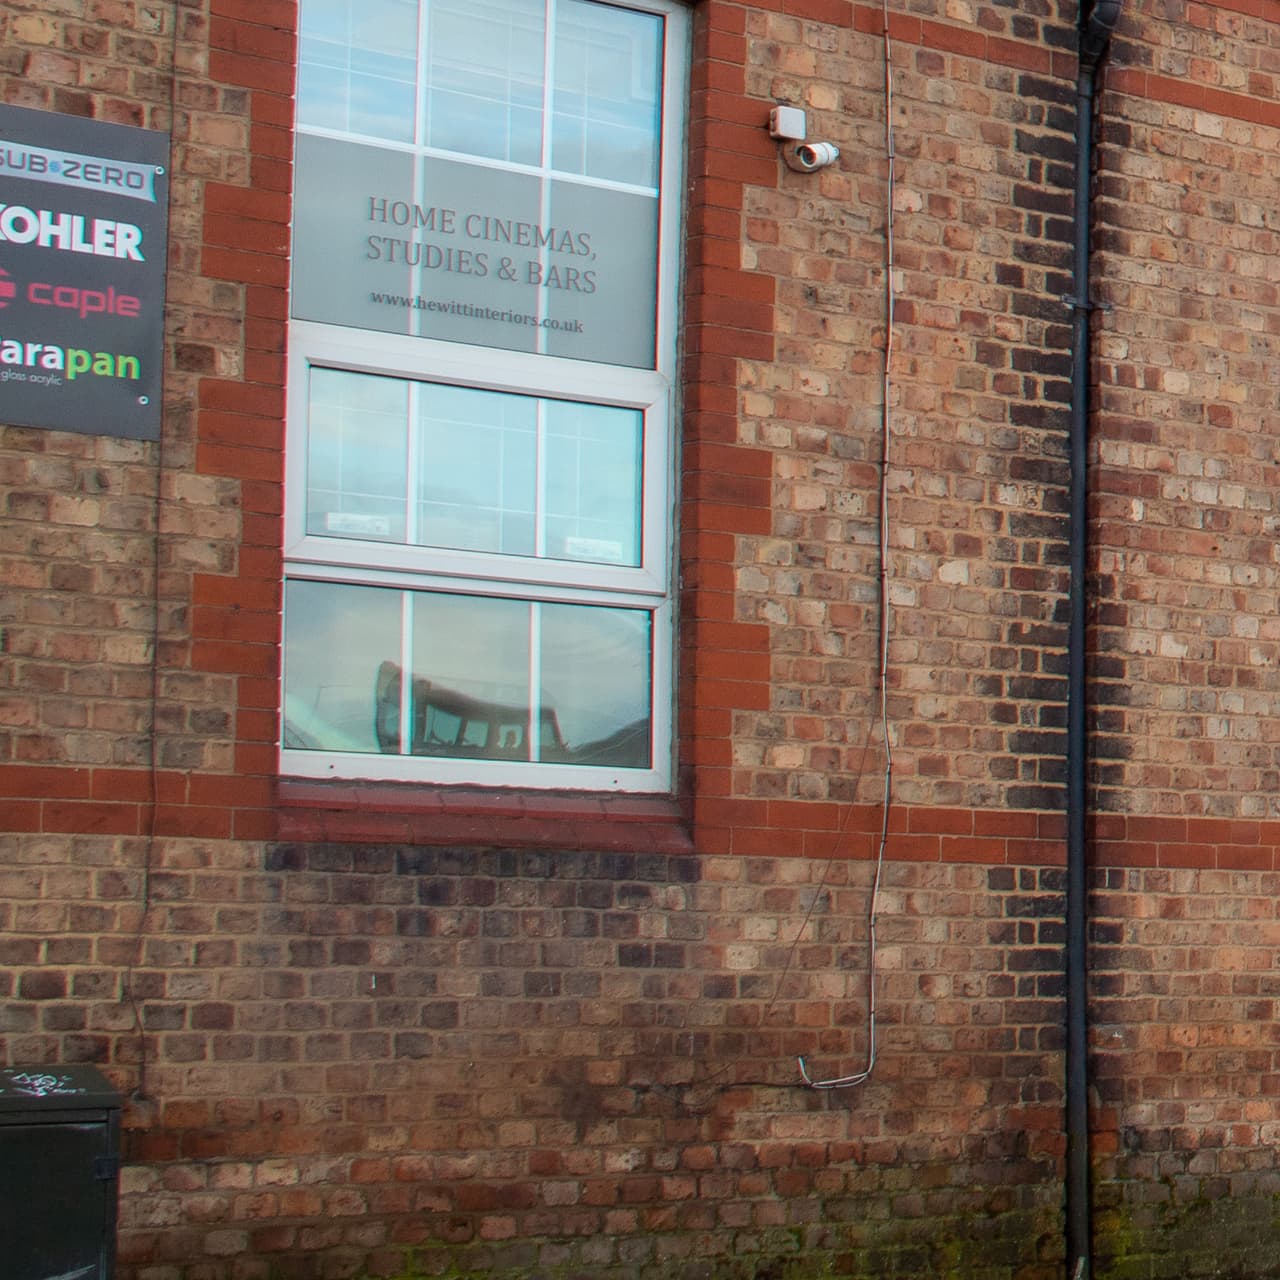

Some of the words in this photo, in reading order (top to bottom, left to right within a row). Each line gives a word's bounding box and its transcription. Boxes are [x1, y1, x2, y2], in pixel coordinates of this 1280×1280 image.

[0, 204, 145, 261] OHLER
[368, 196, 456, 234] HOME
[465, 214, 598, 261] CINEMAS,
[367, 235, 489, 277] STUDIES
[497, 256, 518, 282] &
[527, 261, 597, 294] BARS
[28, 281, 141, 319] caple
[370, 291, 584, 333] www.hewittinteriors.co.uk
[0, 337, 141, 380] arapan
[0, 368, 26, 382] gloss
[30, 373, 63, 387] acrylic
